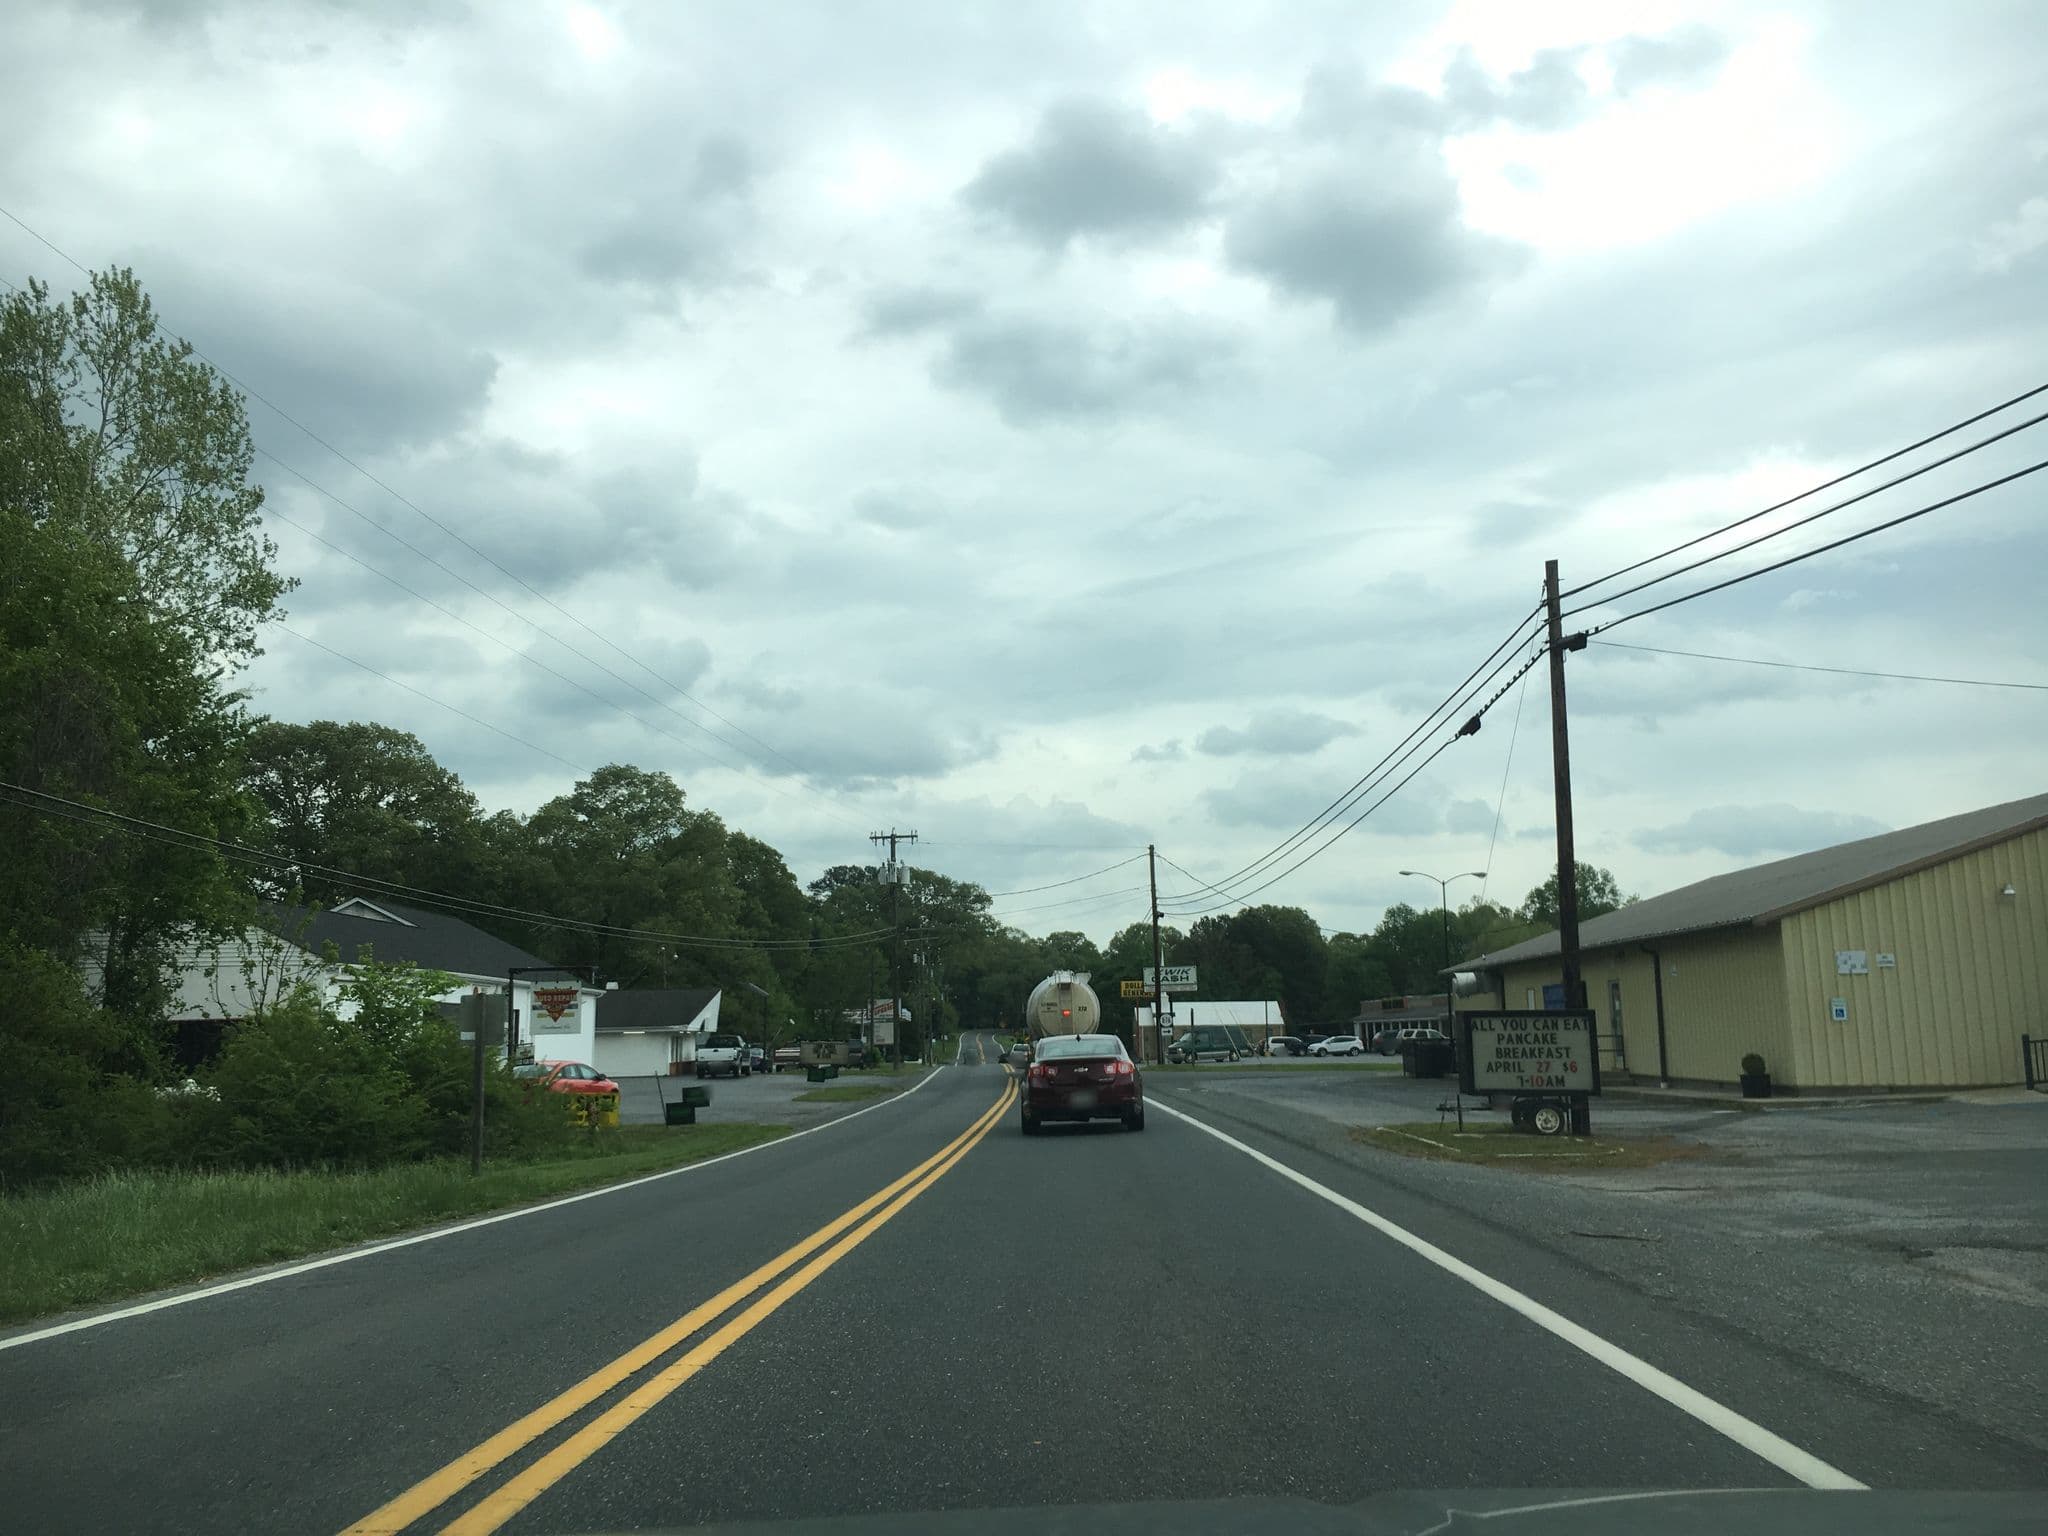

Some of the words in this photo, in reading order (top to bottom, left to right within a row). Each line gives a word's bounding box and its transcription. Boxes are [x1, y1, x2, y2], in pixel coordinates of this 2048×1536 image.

[1159, 968, 1191, 976] WIK
[1471, 1019, 1496, 1032] ALL
[1501, 1019, 1528, 1031] YOU
[1532, 1019, 1559, 1031] CAN
[1563, 1019, 1589, 1031] EAT
[1497, 1033, 1558, 1045] PANCAKE
[1495, 1046, 1572, 1059] BREAKFAST
[1486, 1061, 1525, 1073] APRIL
[1536, 1061, 1552, 1073] 27
[1562, 1061, 1578, 1073] $6
